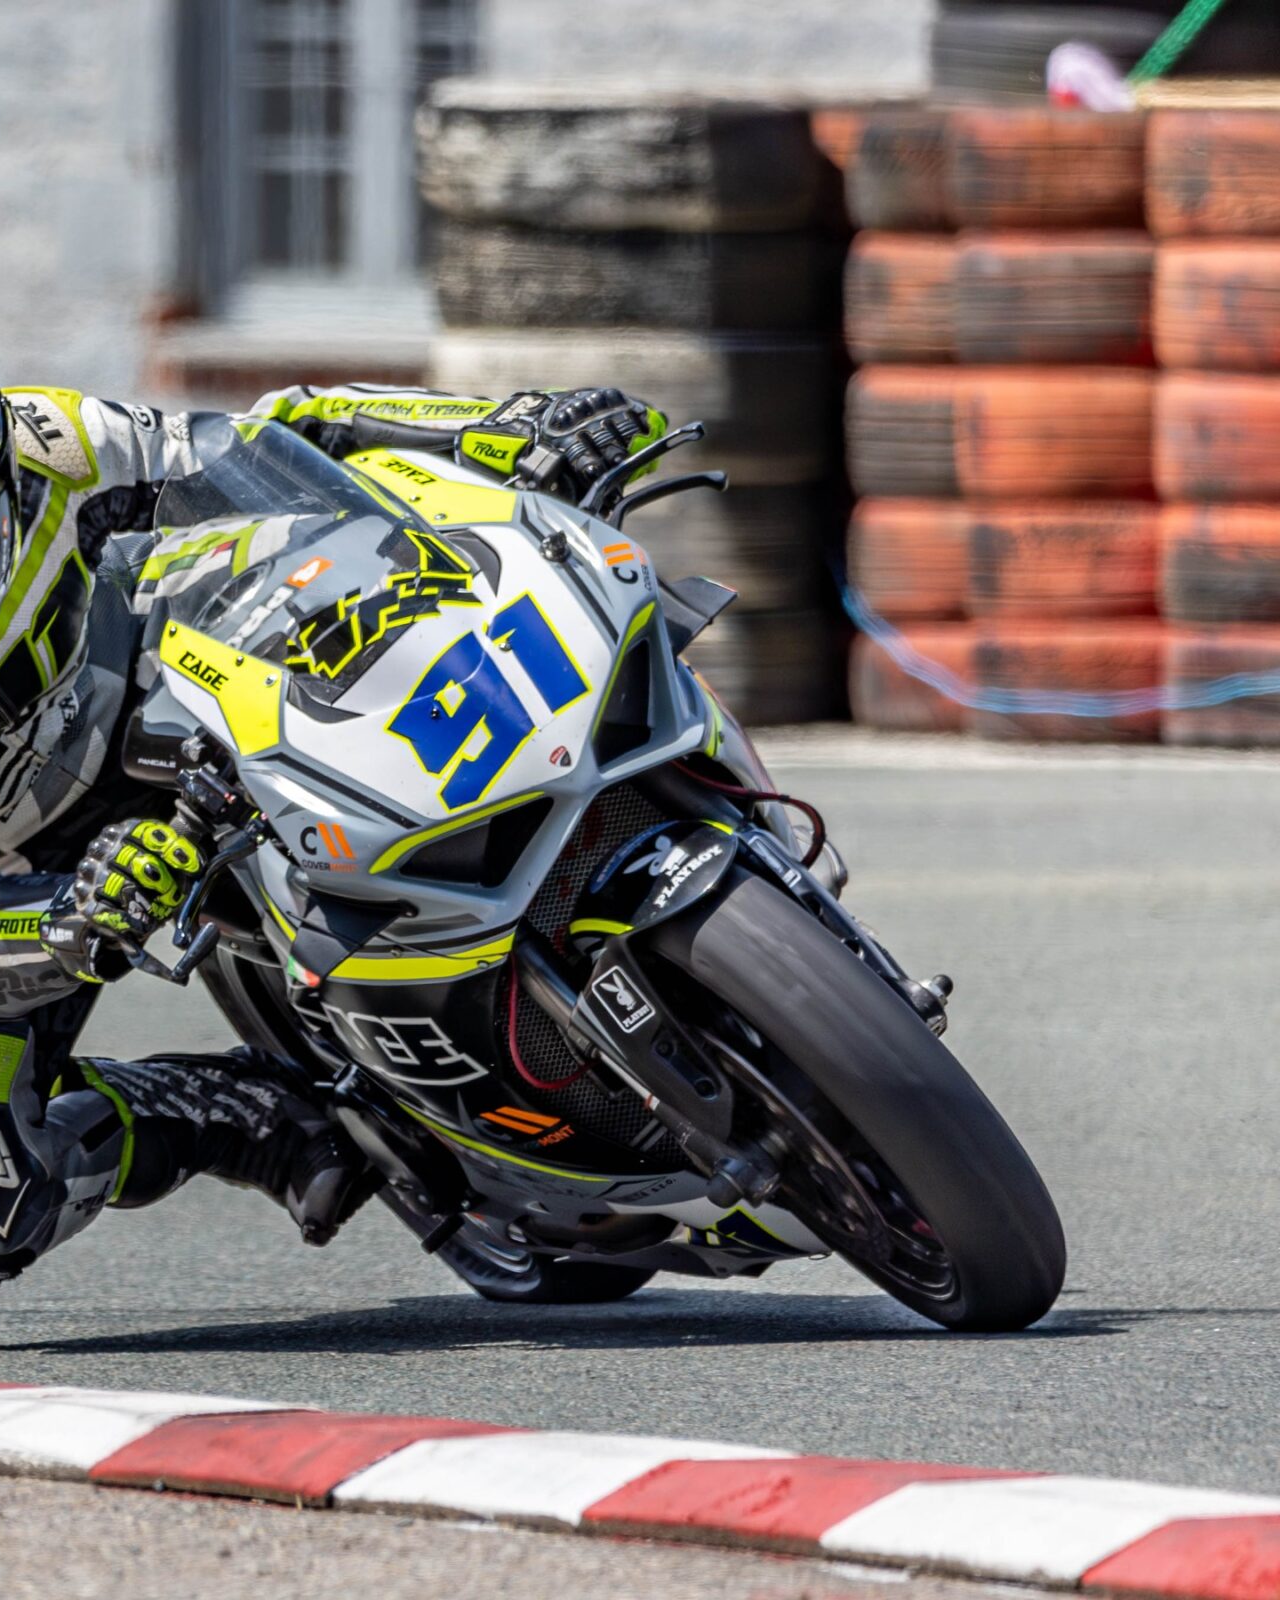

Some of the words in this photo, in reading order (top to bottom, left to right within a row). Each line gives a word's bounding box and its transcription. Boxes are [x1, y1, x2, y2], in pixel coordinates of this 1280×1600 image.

[178, 651, 229, 691] CAGE
[386, 592, 591, 813] 91
[653, 844, 723, 909] PLAYBOY
